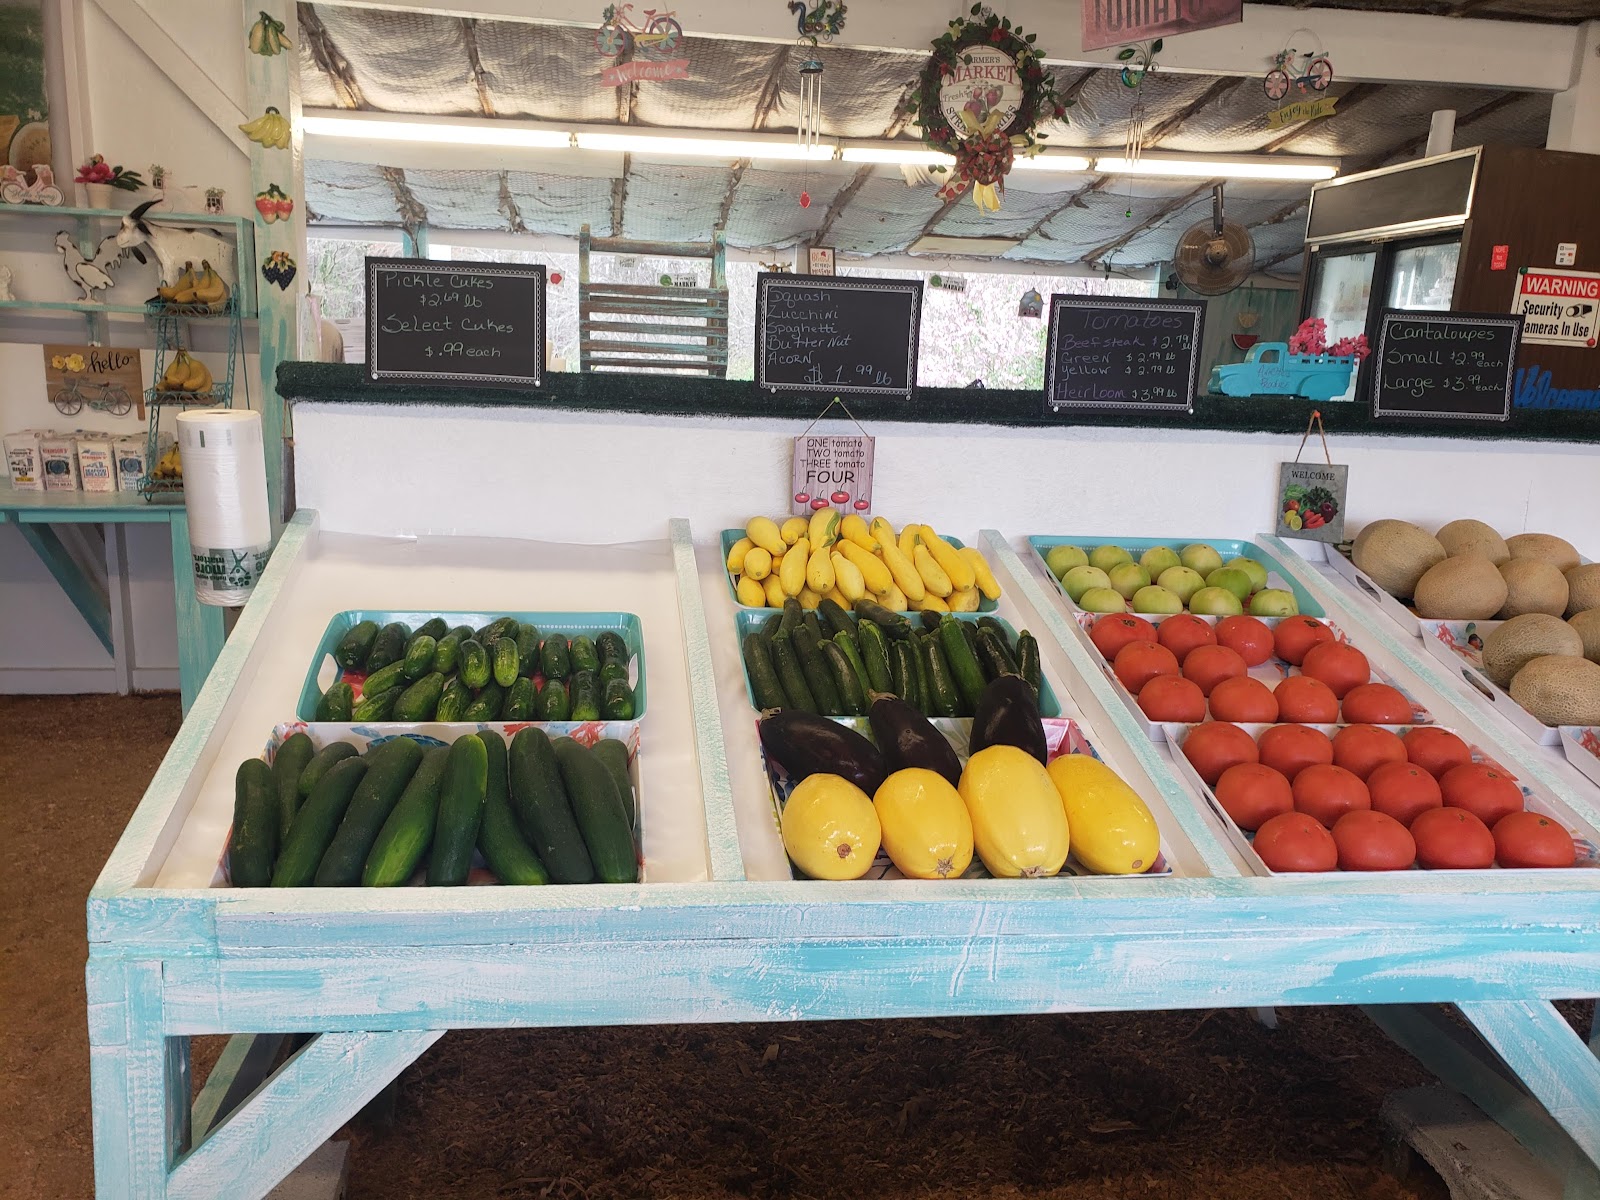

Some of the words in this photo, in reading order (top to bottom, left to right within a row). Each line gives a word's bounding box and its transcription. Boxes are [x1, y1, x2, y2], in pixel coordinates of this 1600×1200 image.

[616, 62, 672, 83] Welcome
[947, 65, 1017, 87] MARKET
[383, 271, 444, 288] Pickle
[450, 275, 494, 289] Cukes
[1526, 277, 1598, 297] WARNING
[464, 294, 483, 308] lb
[769, 287, 831, 308] Squash
[1079, 309, 1183, 329] Tomatoes
[1522, 300, 1564, 320] Security
[381, 314, 452, 333] Select
[461, 318, 514, 333] Cukes
[766, 322, 838, 339] Spaghetti
[1389, 322, 1496, 342] Cantaloupes
[1525, 322, 1559, 336] ameras
[1561, 321, 1571, 336] In
[1573, 322, 1590, 337] Use
[466, 347, 501, 358] each
[1387, 347, 1443, 365] Small
[1476, 360, 1504, 368] each
[87, 350, 134, 374] hello
[1384, 374, 1436, 398] Large
[1475, 384, 1504, 392] each
[807, 438, 829, 448] ONE
[832, 439, 863, 448] tomato
[807, 448, 831, 458] TWO
[834, 449, 865, 458] tomato
[799, 459, 832, 468] THREE
[834, 460, 866, 468] tomato
[806, 470, 855, 484] FOUR
[1291, 470, 1336, 480] WELCOME
[195, 562, 226, 574] more
